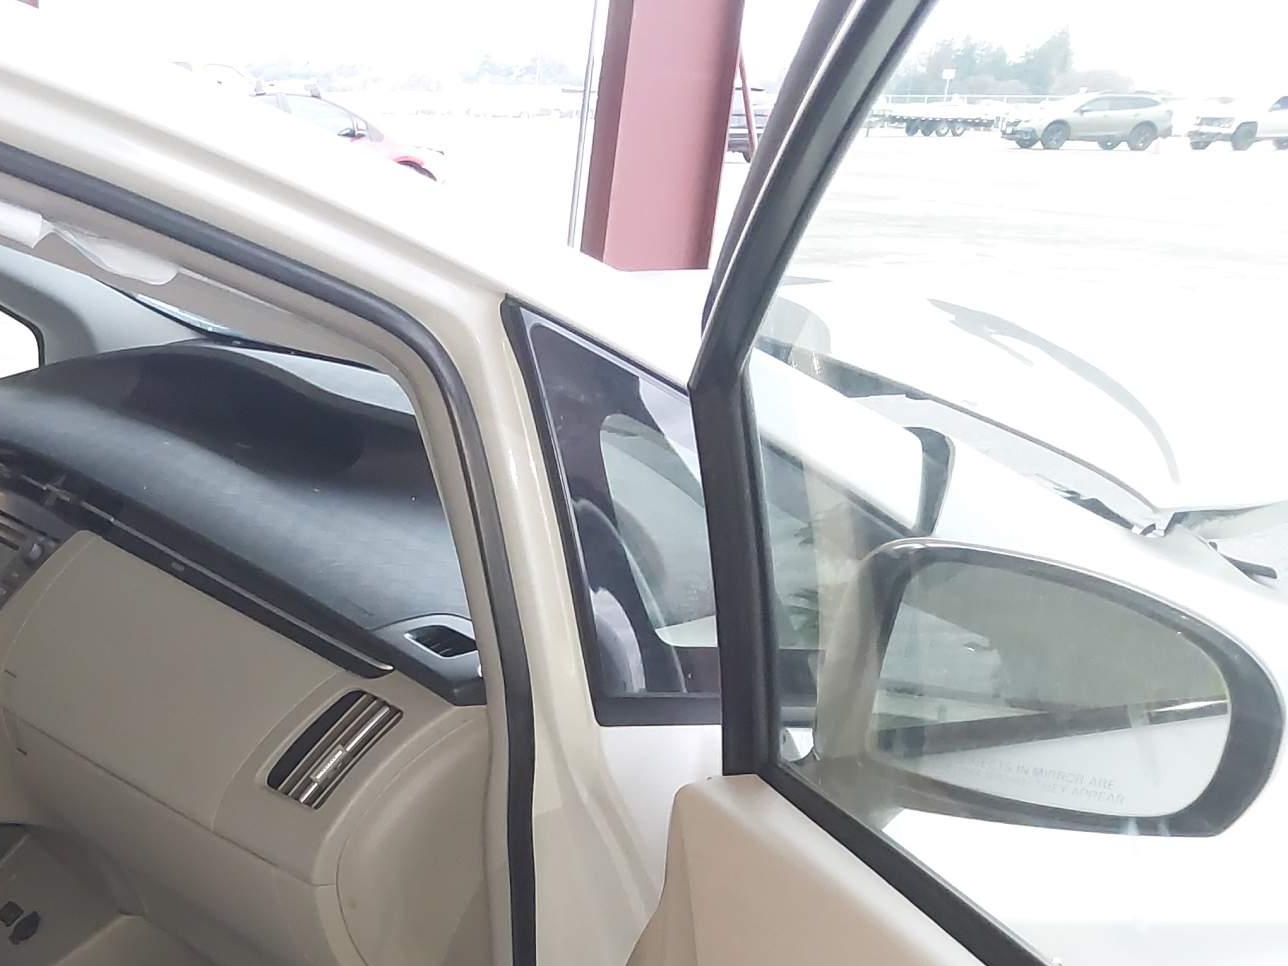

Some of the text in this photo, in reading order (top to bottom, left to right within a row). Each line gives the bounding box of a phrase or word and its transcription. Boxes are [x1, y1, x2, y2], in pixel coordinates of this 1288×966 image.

[1031, 766, 1084, 785] MIRROR
[1088, 775, 1116, 790] ARE
[1072, 787, 1126, 805] APPEAR
